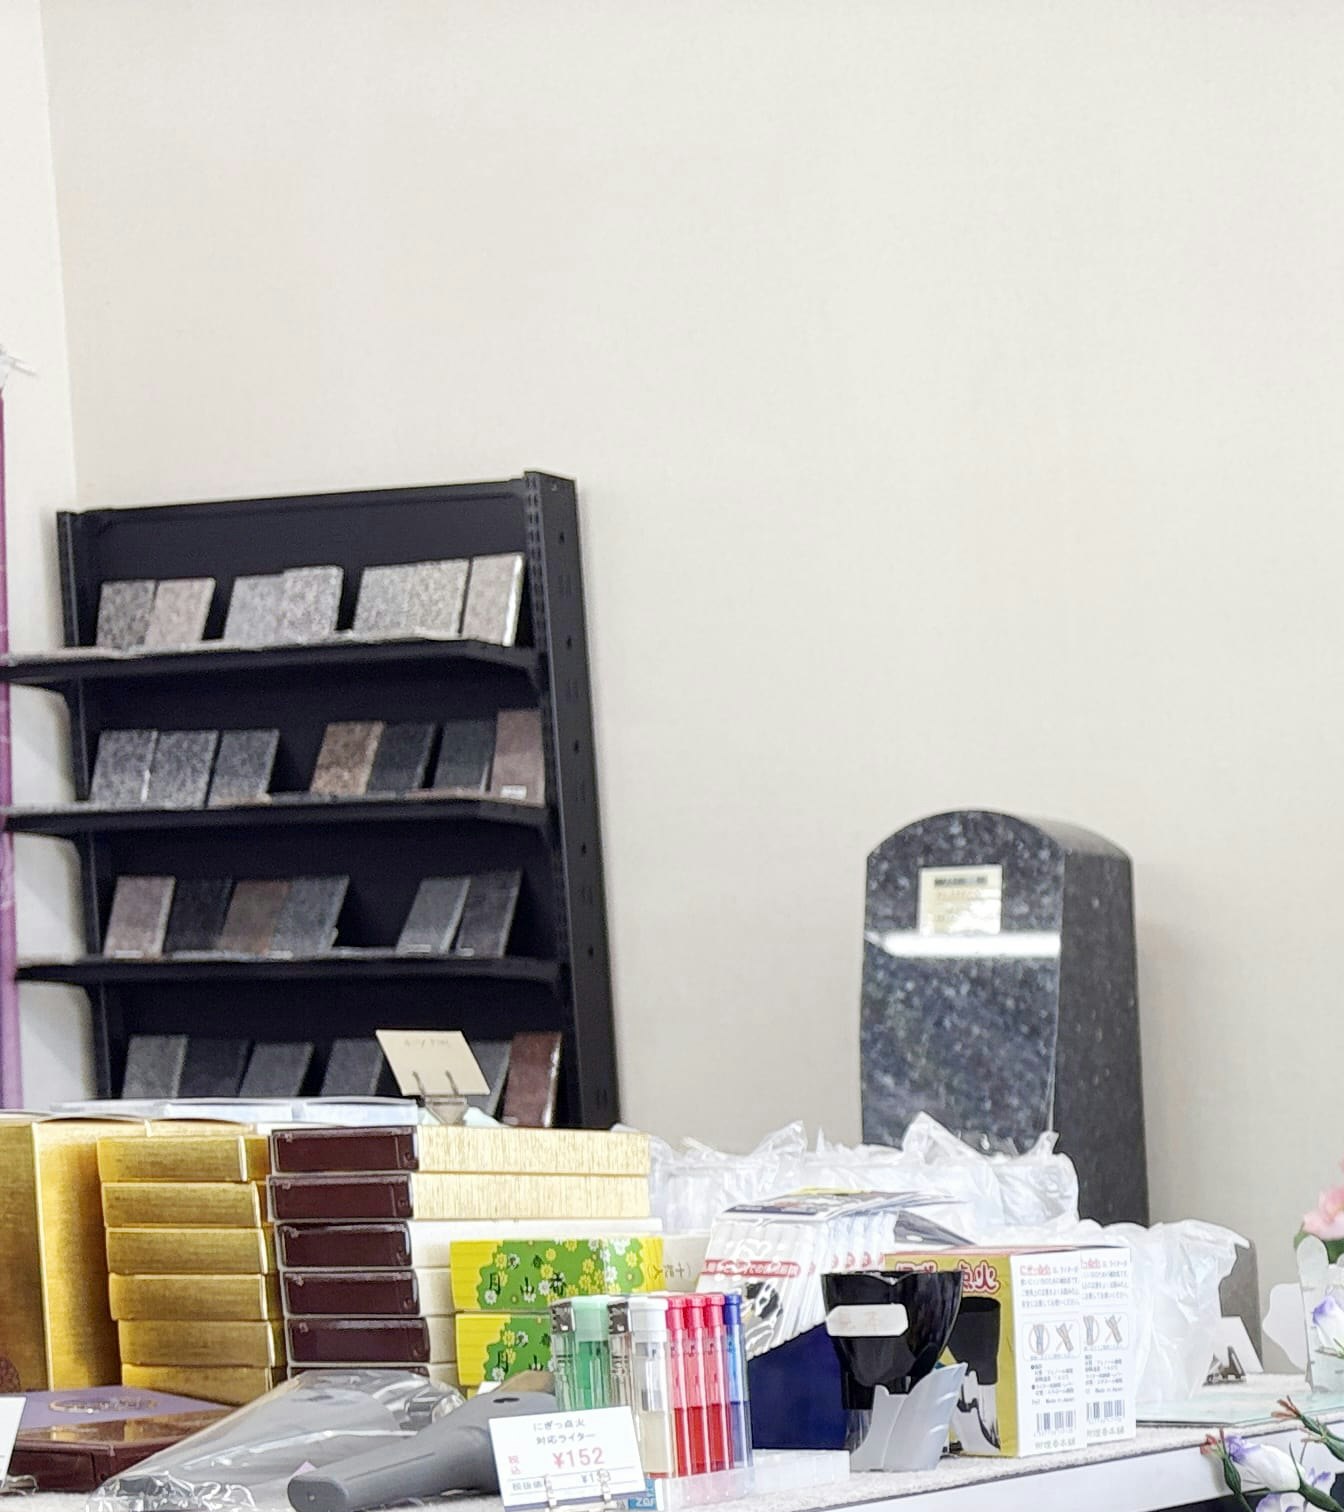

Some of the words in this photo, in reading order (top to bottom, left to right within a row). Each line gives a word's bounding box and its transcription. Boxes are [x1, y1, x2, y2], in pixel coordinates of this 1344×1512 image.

[536, 1432, 596, 1445] 対応ライター
[552, 1447, 605, 1469] ¥152
